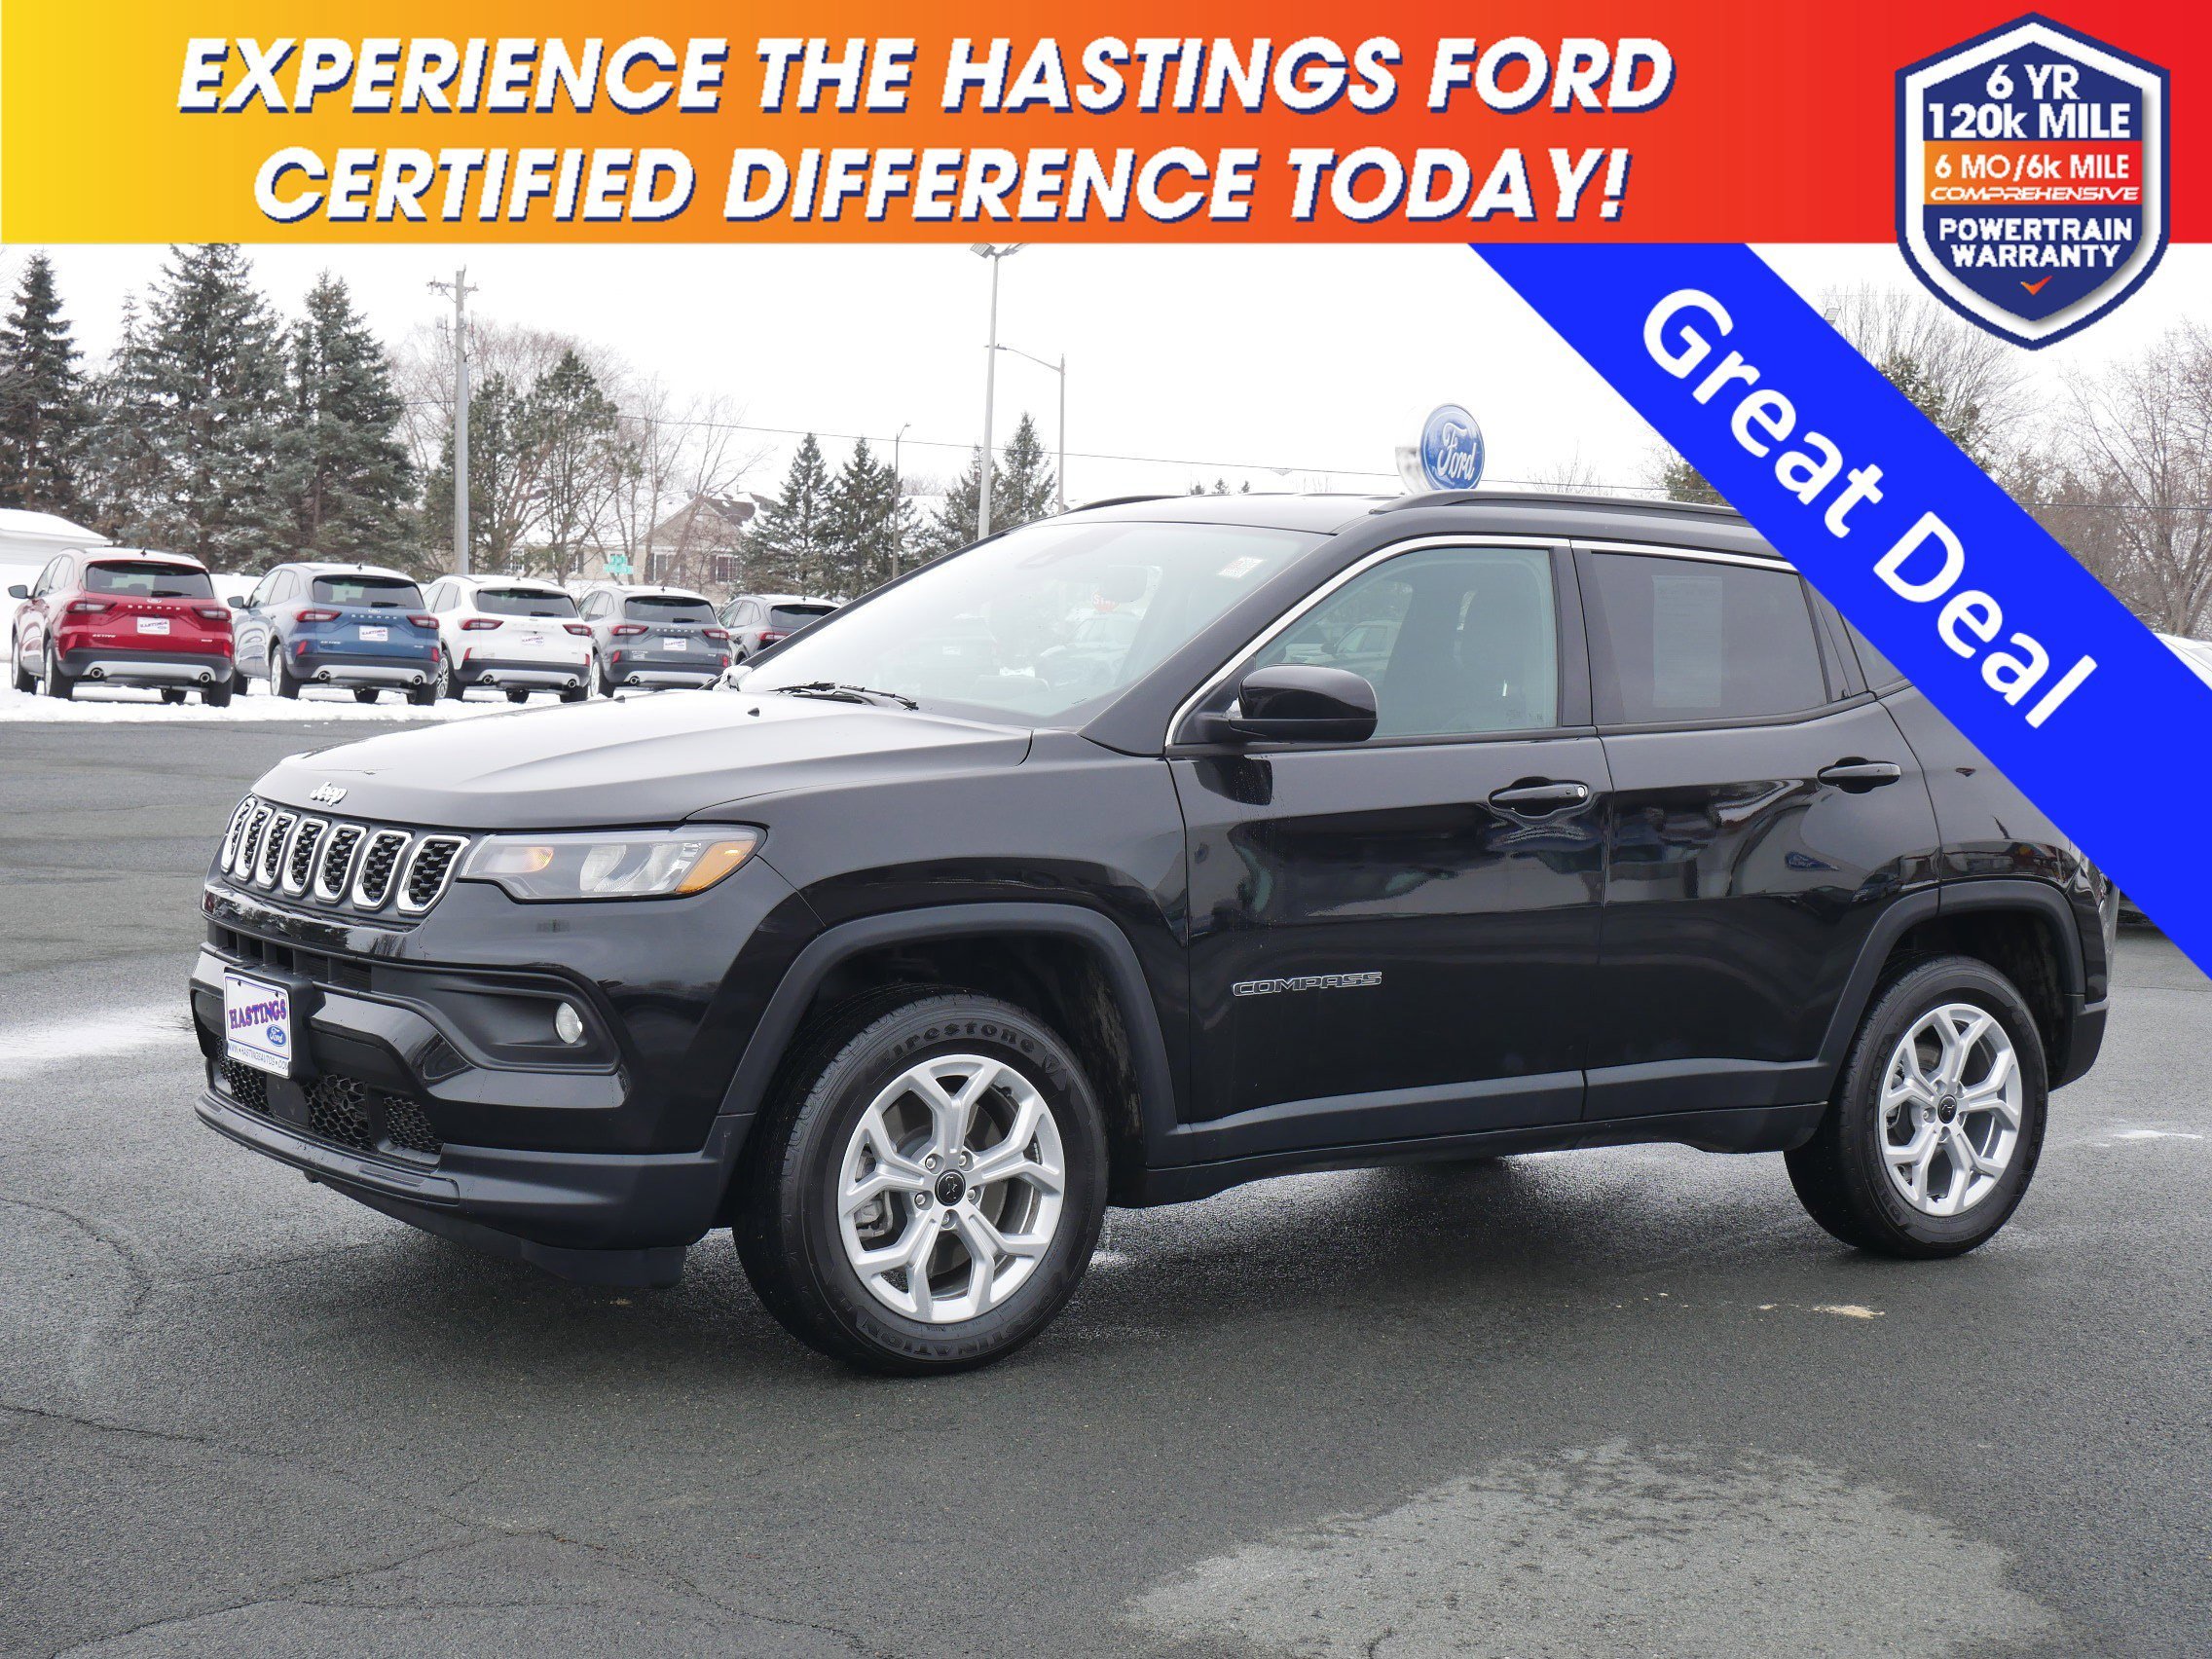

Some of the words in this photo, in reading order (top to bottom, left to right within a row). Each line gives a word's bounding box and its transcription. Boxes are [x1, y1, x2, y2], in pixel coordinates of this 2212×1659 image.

[310, 781, 349, 807] Jeep
[1233, 972, 1382, 997] COMPASS
[228, 998, 287, 1030] HASTINGS
